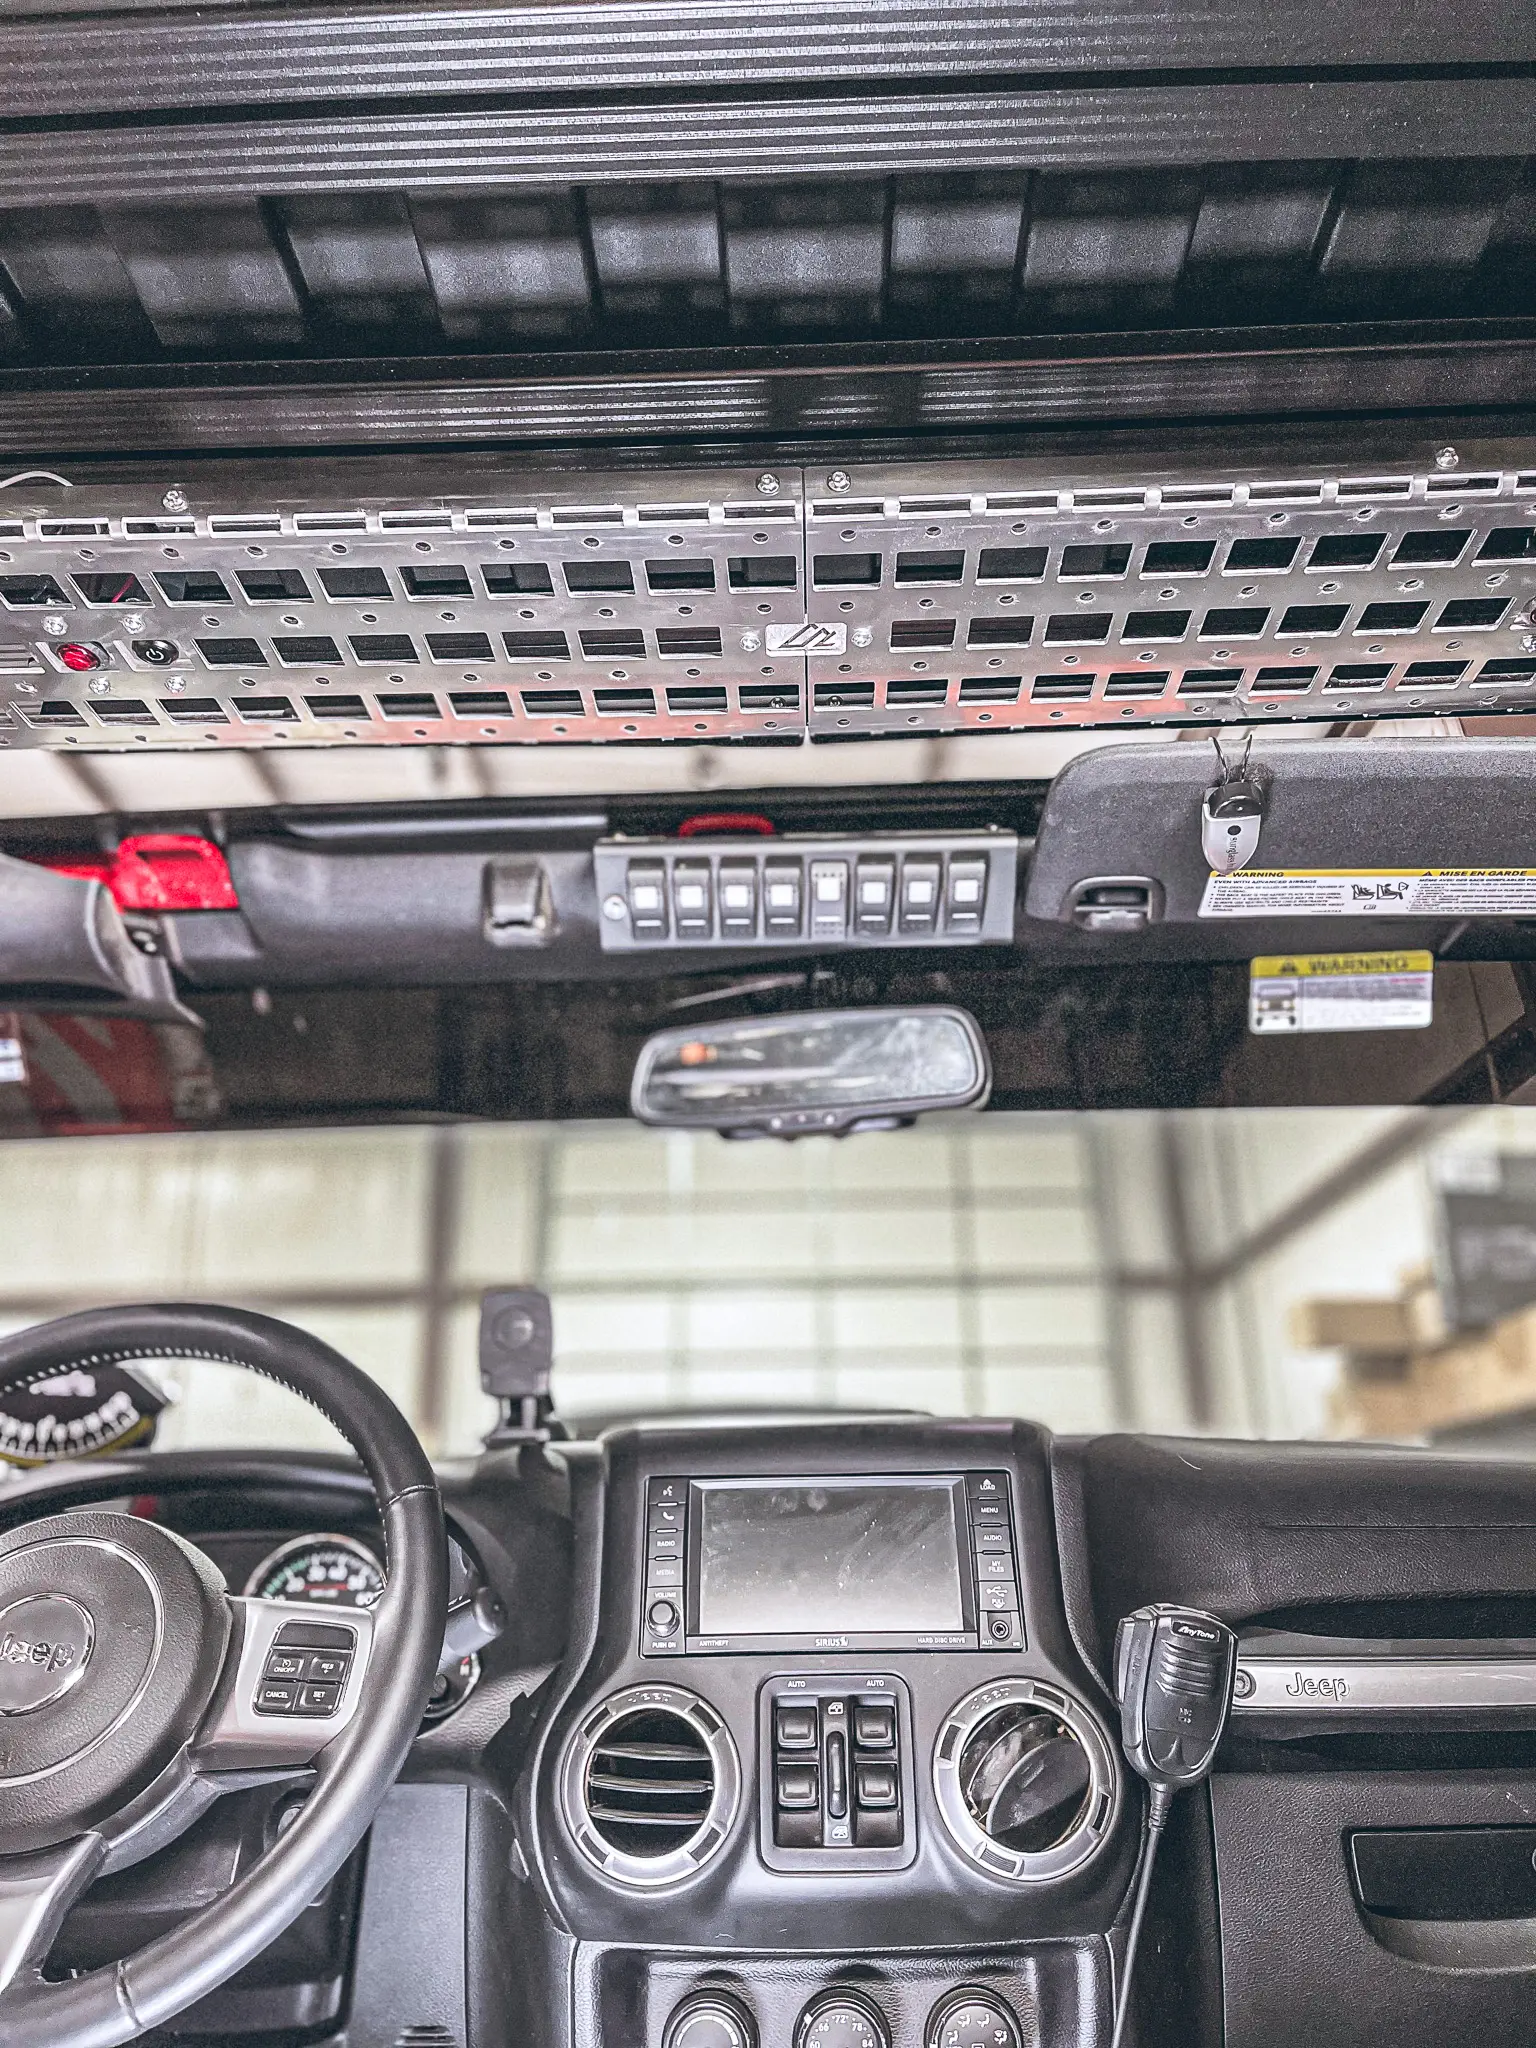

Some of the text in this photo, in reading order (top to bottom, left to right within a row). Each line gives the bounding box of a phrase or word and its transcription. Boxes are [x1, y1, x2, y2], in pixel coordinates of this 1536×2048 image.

[1226, 837, 1239, 863] sunglass
[1178, 1625, 1215, 1640] AnyTone
[815, 1638, 840, 1647] SIRIUS
[787, 1680, 806, 1688] AUTO
[866, 1679, 884, 1687] AUTO
[1285, 1672, 1350, 1701] Jeep
[835, 2015, 846, 2024] 72
[818, 2023, 829, 2031] 66
[852, 2023, 863, 2031] 78
[862, 2039, 873, 2048] 84
